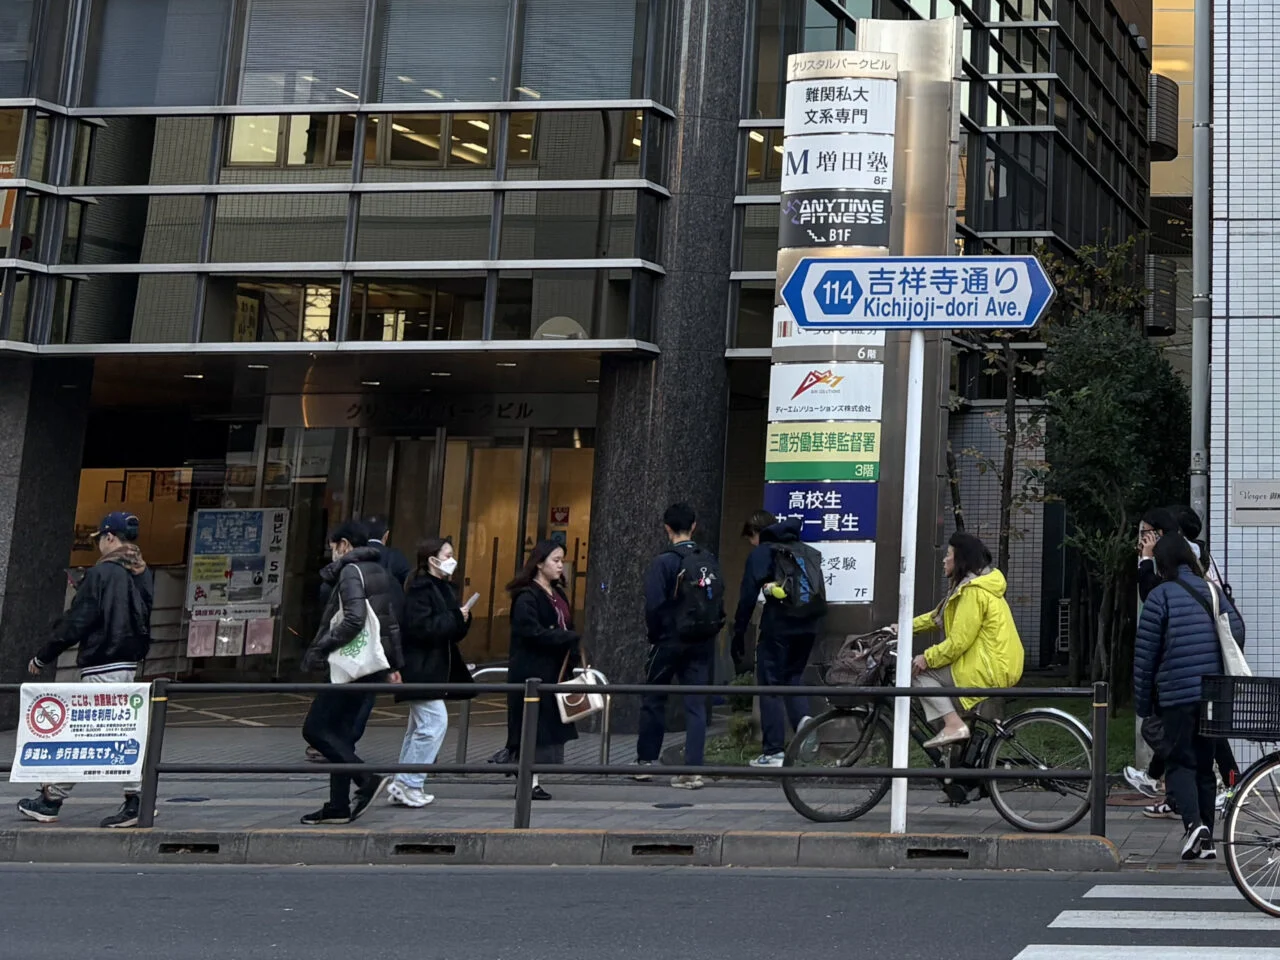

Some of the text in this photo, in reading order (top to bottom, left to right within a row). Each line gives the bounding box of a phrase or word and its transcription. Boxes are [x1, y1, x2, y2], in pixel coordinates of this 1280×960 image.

[792, 57, 891, 73] クリスタルパークビル
[805, 85, 869, 103] 難関私大
[803, 107, 869, 125] 文系専門
[816, 150, 888, 173] 増田塾
[873, 175, 888, 185] 8F
[799, 198, 885, 214] ANYTIME
[829, 228, 852, 242] B1F
[867, 266, 1018, 296] 吉祥寺通り
[822, 280, 854, 305] 114
[863, 296, 1022, 321] Kichijoji-dori Ave.
[857, 346, 877, 359] 6階
[769, 431, 876, 453] 三鷹労働基準監督署
[854, 463, 874, 477] 3階
[788, 490, 842, 510] 高校生
[775, 512, 860, 532] 一貫生
[854, 588, 868, 597] 7F
